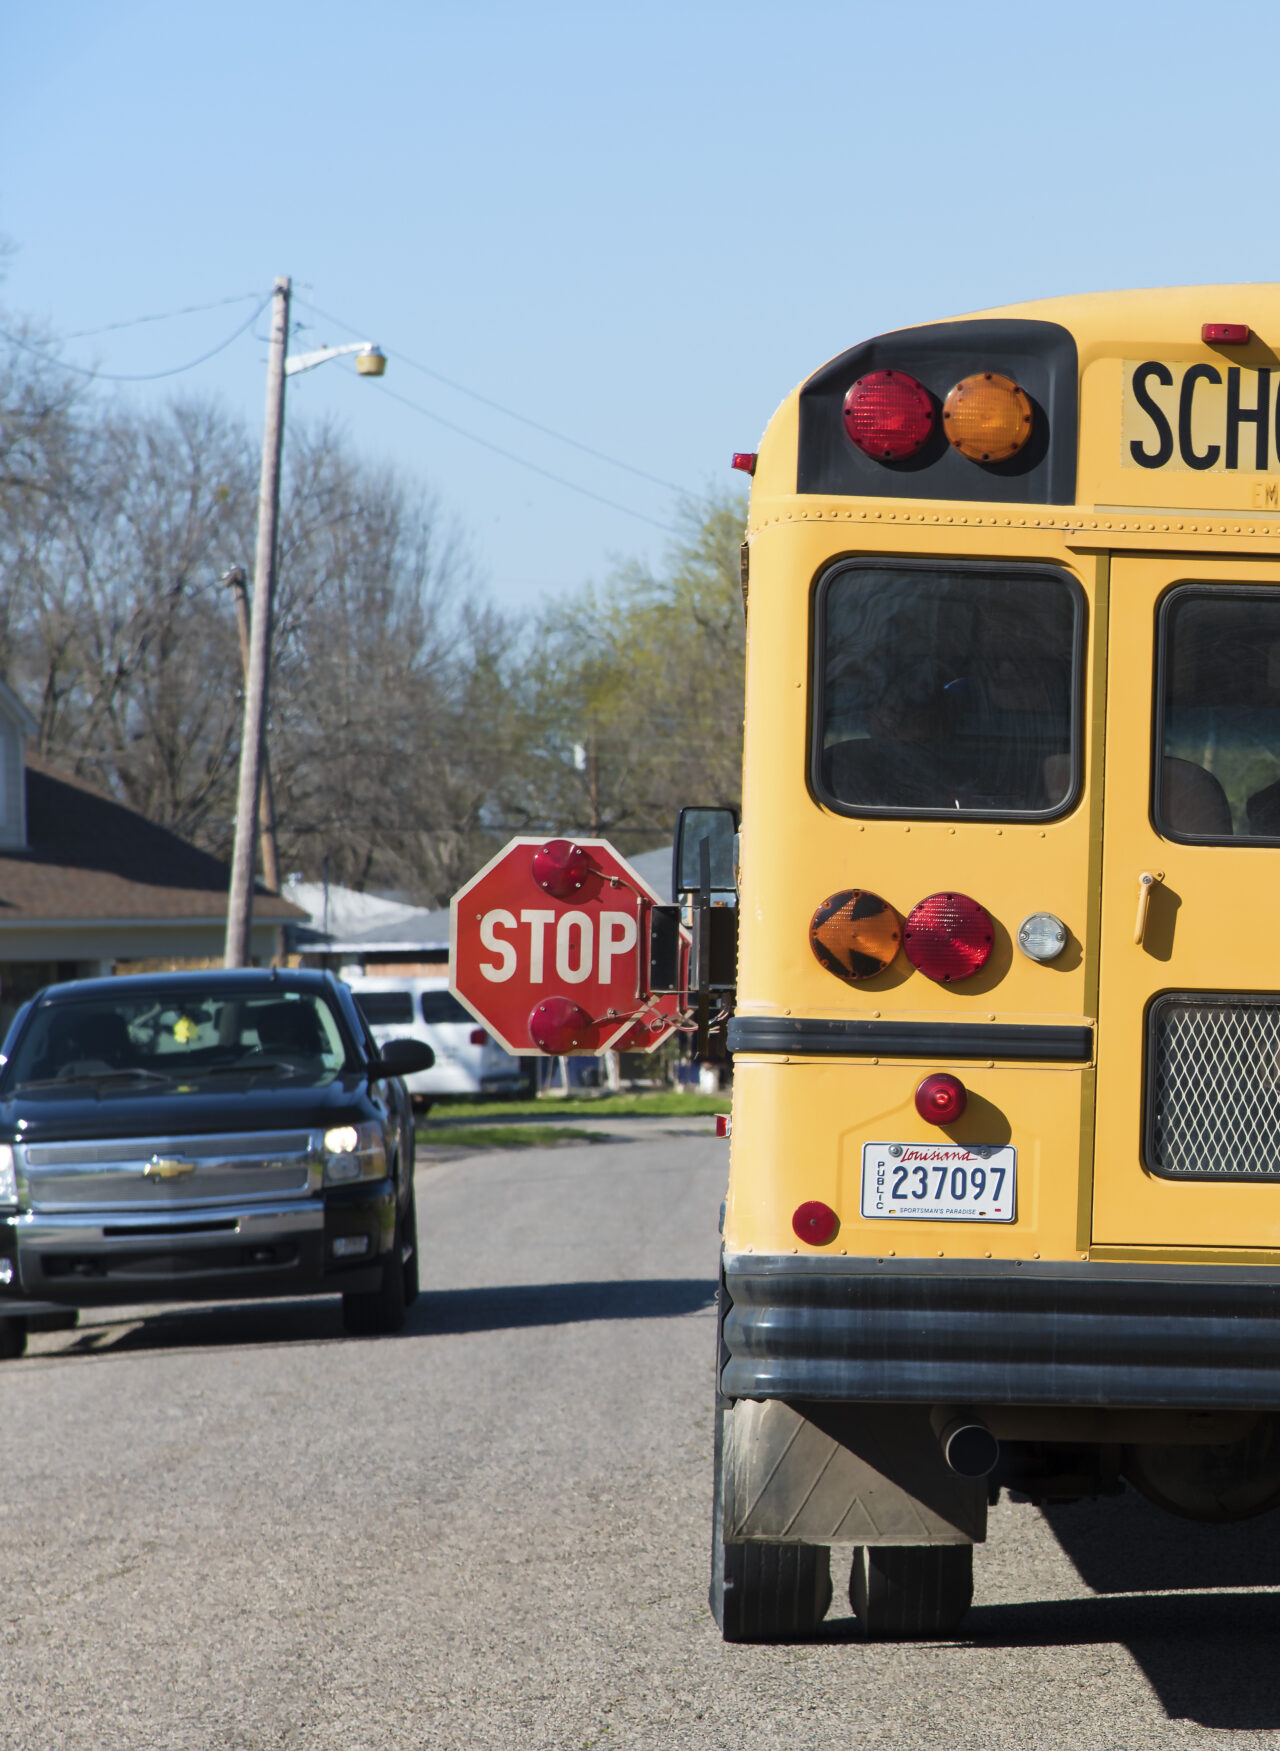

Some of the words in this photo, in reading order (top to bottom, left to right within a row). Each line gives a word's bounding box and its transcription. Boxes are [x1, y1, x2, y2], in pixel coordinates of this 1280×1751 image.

[479, 908, 638, 985] STOP
[900, 1147, 978, 1163] Louisiana
[876, 1161, 886, 1210] PUBLIC
[891, 1165, 1006, 1202] 237097
[899, 1207, 944, 1215] SPORTSMAN'S
